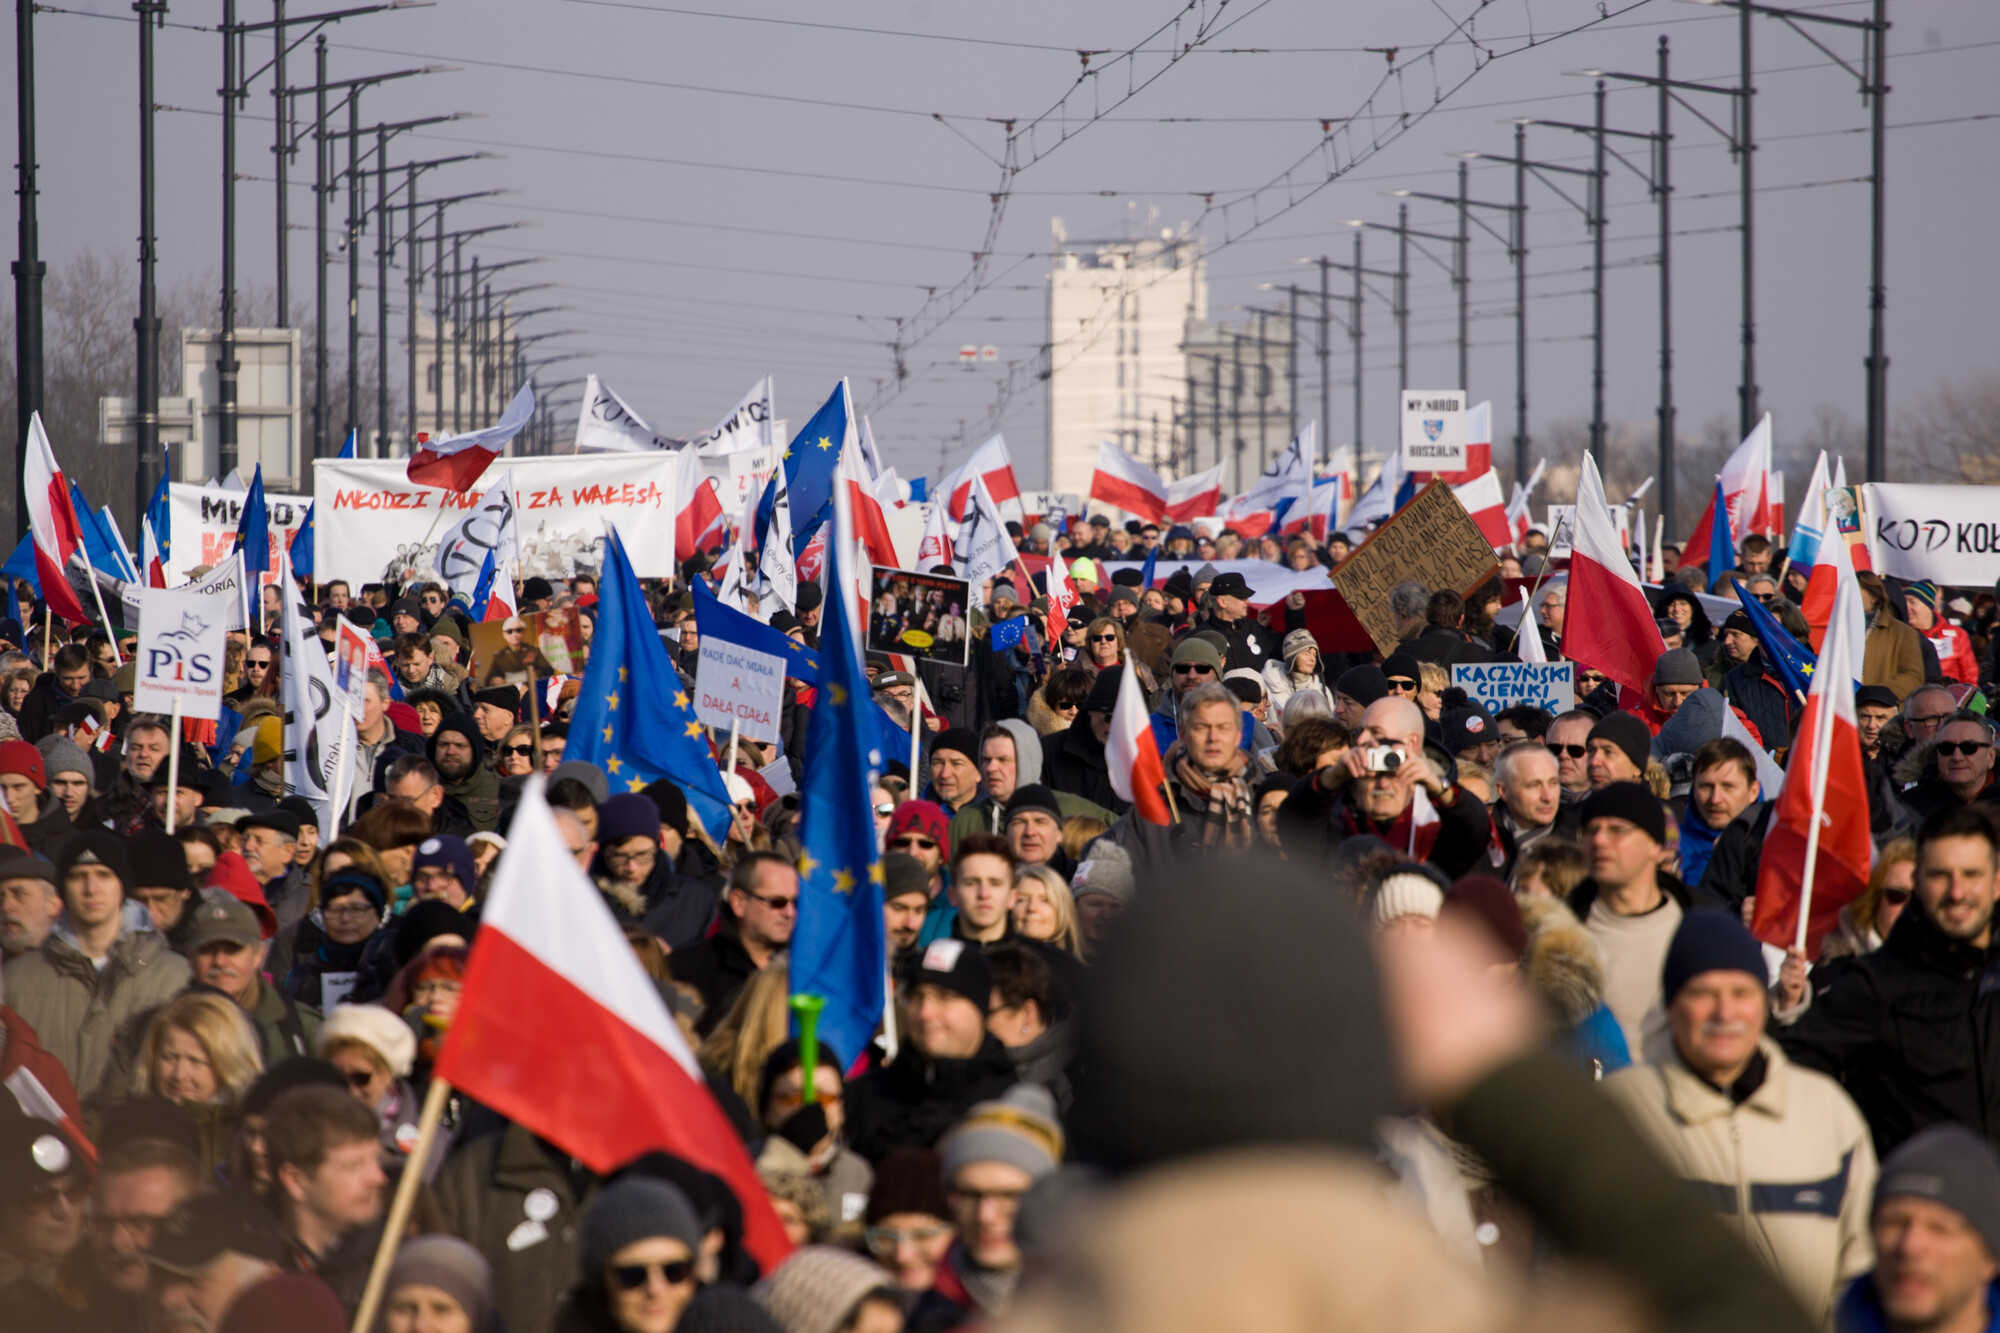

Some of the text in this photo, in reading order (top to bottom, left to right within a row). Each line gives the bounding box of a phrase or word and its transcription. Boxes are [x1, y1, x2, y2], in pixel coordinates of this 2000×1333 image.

[333, 489, 432, 510] MŁODZI
[528, 487, 563, 509] ZA
[572, 481, 662, 508] WAŁĘSĄ
[1334, 481, 1451, 600] ZAWODZI PRZED BAŁWANEM
[1877, 516, 1950, 552] KOD
[1455, 537, 1494, 574] NASZ
[146, 648, 212, 683] PiS
[1456, 662, 1570, 684] KACZYŃSKI
[731, 676, 739, 690] A
[1477, 682, 1549, 699] CIENKI
[702, 693, 771, 726] DAŁA CIAŁA
